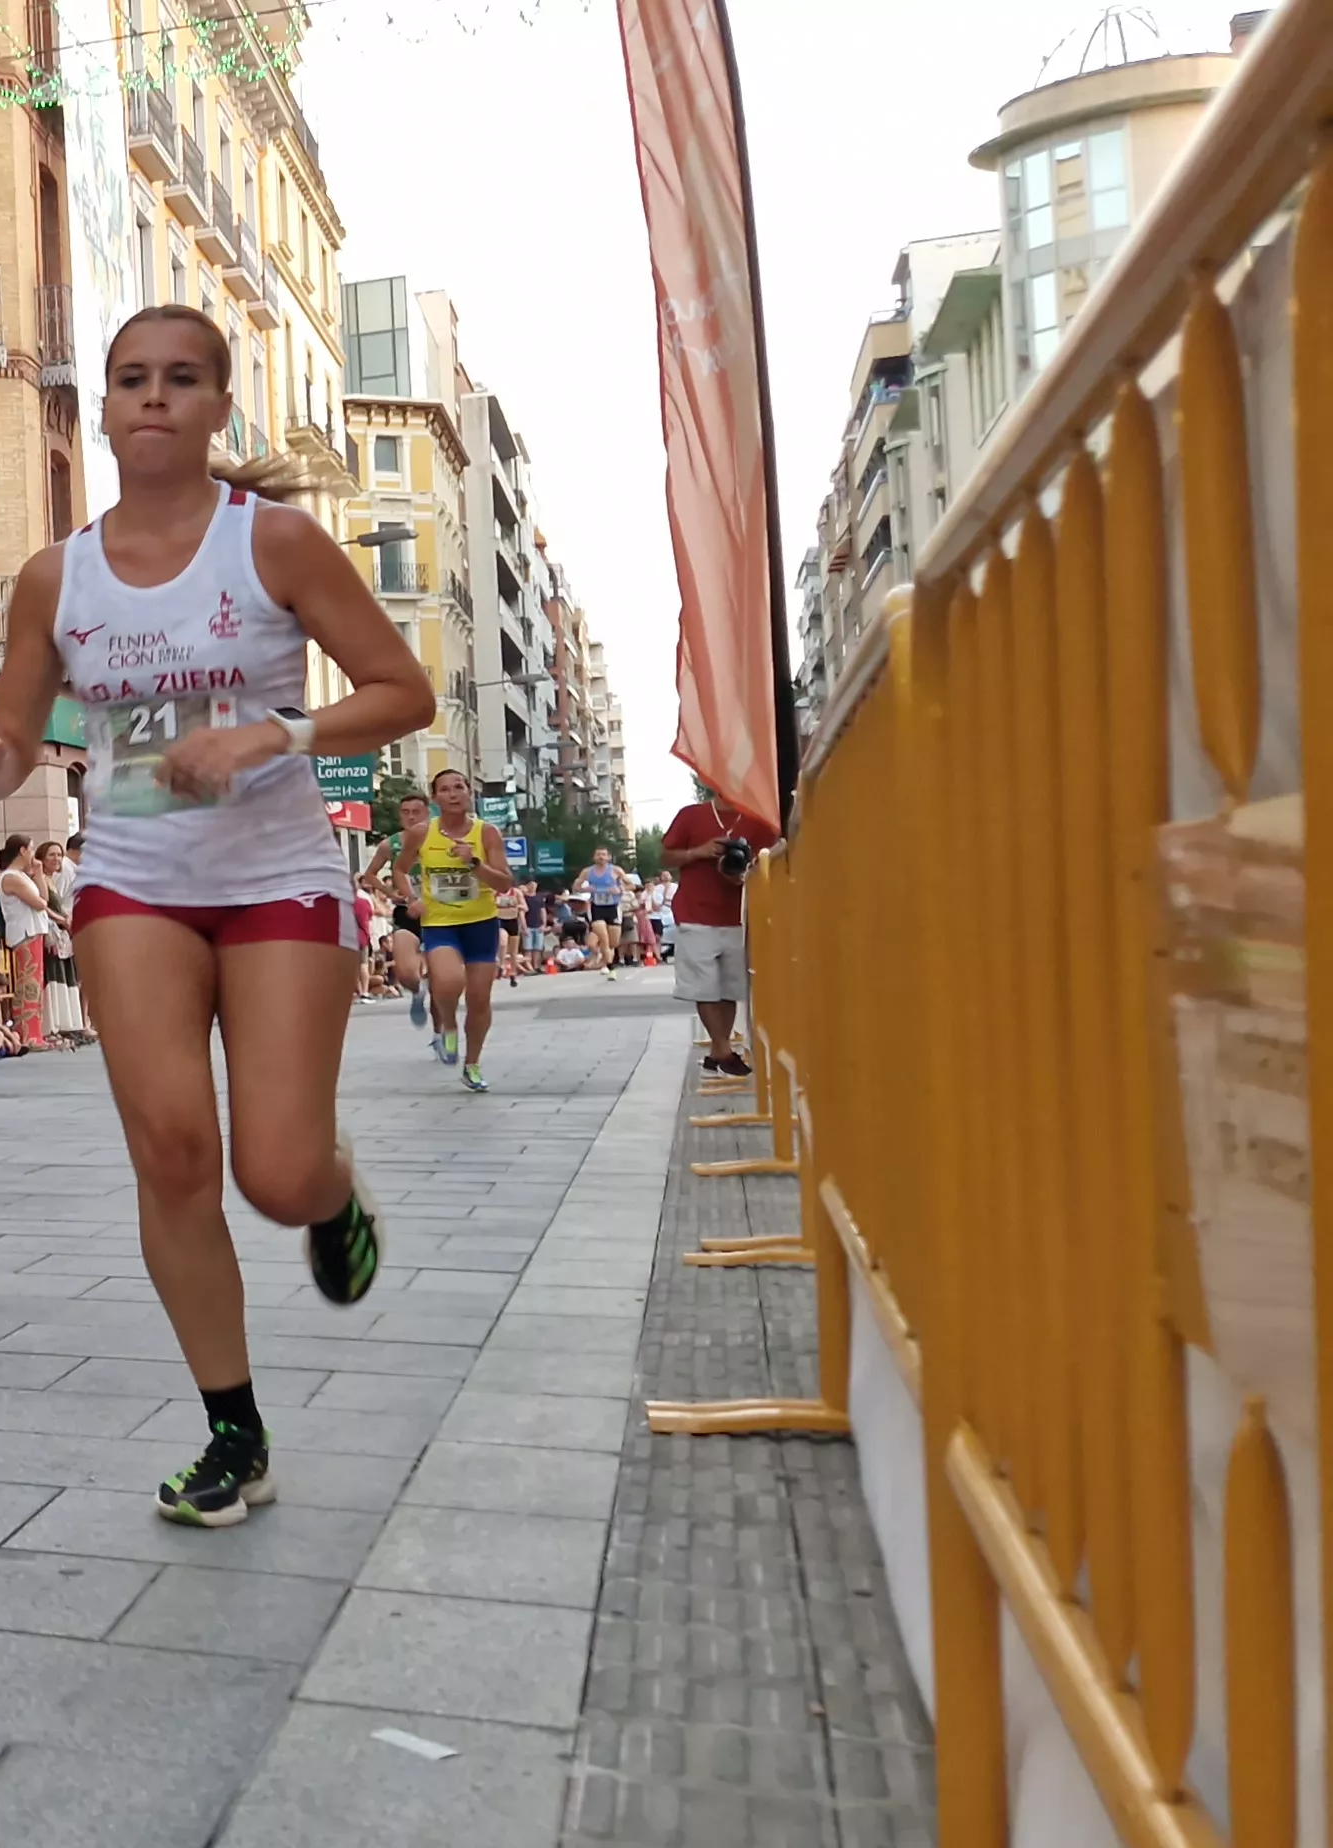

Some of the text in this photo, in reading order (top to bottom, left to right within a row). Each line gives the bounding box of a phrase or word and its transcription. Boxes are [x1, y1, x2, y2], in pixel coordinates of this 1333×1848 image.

[153, 666, 246, 695] ZUERA
[129, 700, 178, 746] 21
[318, 767, 369, 779] Lorenzo
[445, 875, 463, 885] 17
